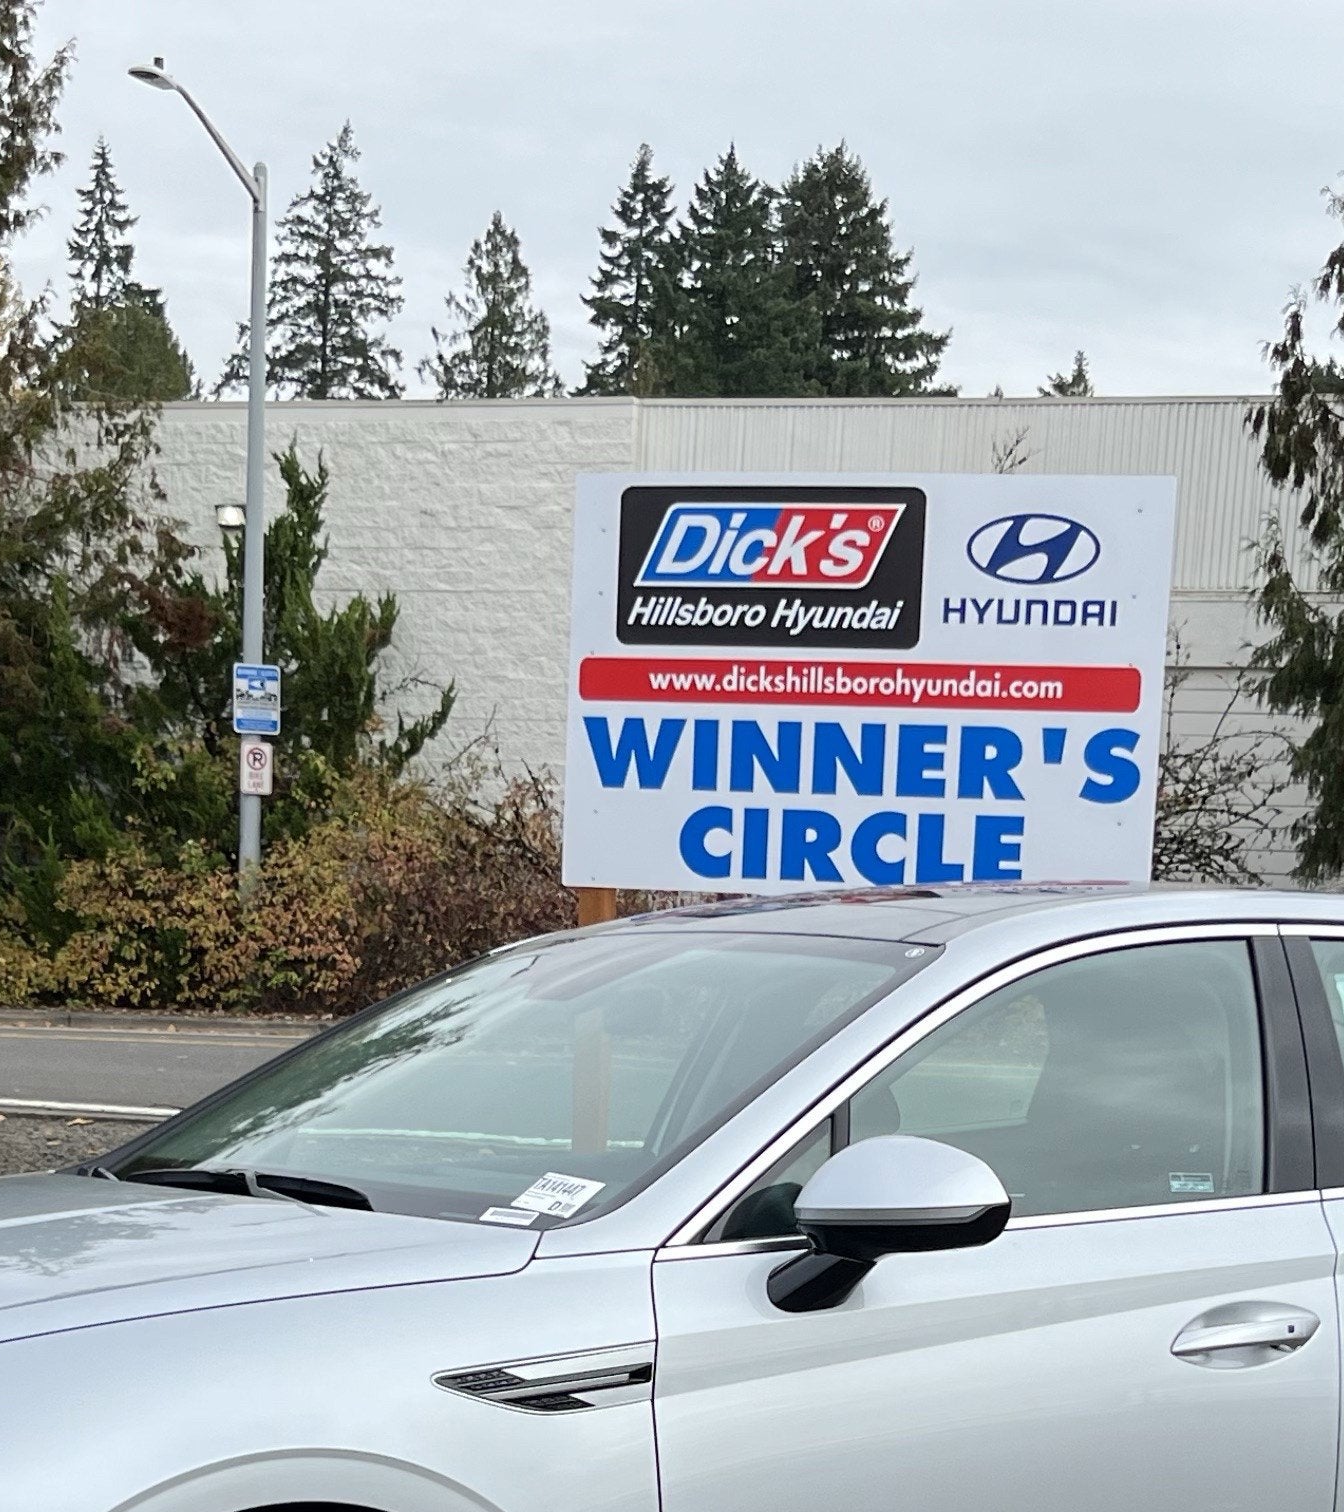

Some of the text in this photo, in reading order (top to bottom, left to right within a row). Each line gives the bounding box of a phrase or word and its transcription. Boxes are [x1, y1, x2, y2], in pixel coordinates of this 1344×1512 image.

[627, 596, 904, 636] Hillsboro Hyundai
[943, 597, 1118, 627] HYUNDAI
[648, 667, 1064, 703] www.dickshillsborohyundai.com
[582, 715, 1142, 804] WINNER'S
[678, 805, 1026, 885] CIRCLE
